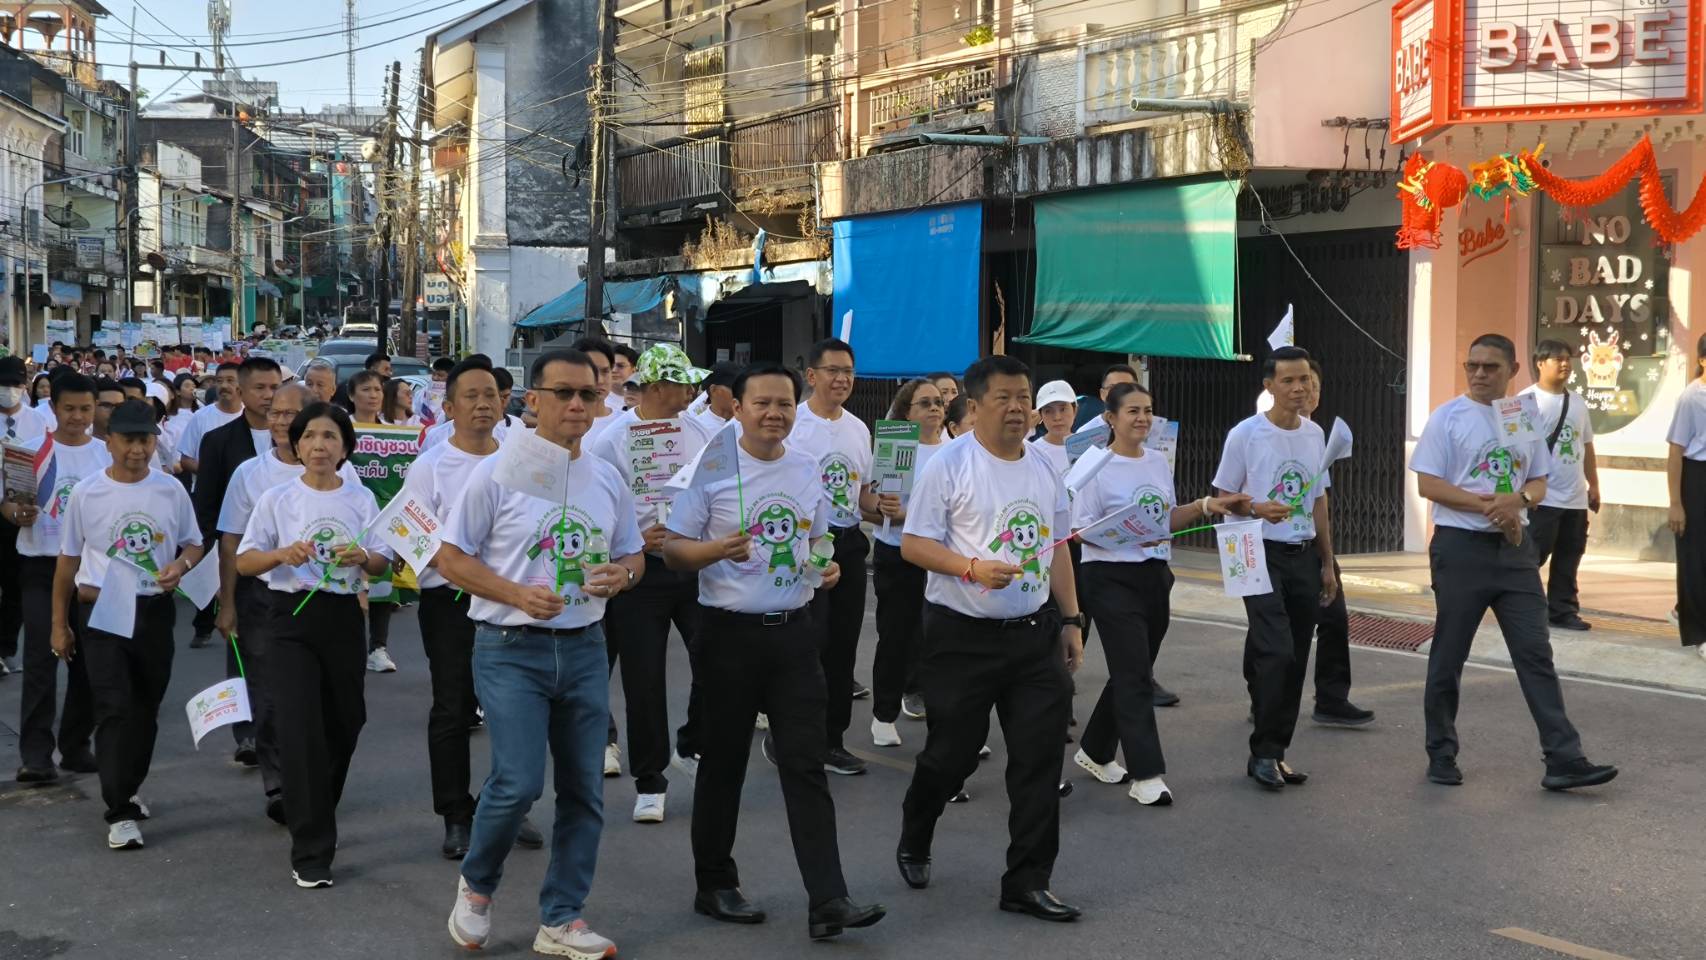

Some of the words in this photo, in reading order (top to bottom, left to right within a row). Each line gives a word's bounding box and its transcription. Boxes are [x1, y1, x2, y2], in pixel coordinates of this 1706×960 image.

[1480, 10, 1672, 69] BABE
[1395, 30, 1431, 93] BABE
[1458, 217, 1506, 257] Babe
[1582, 215, 1632, 246] NO
[1569, 255, 1643, 287] BAD
[1554, 293, 1650, 324] DAYS
[774, 576, 783, 587] 8
[1021, 581, 1030, 593] 8
